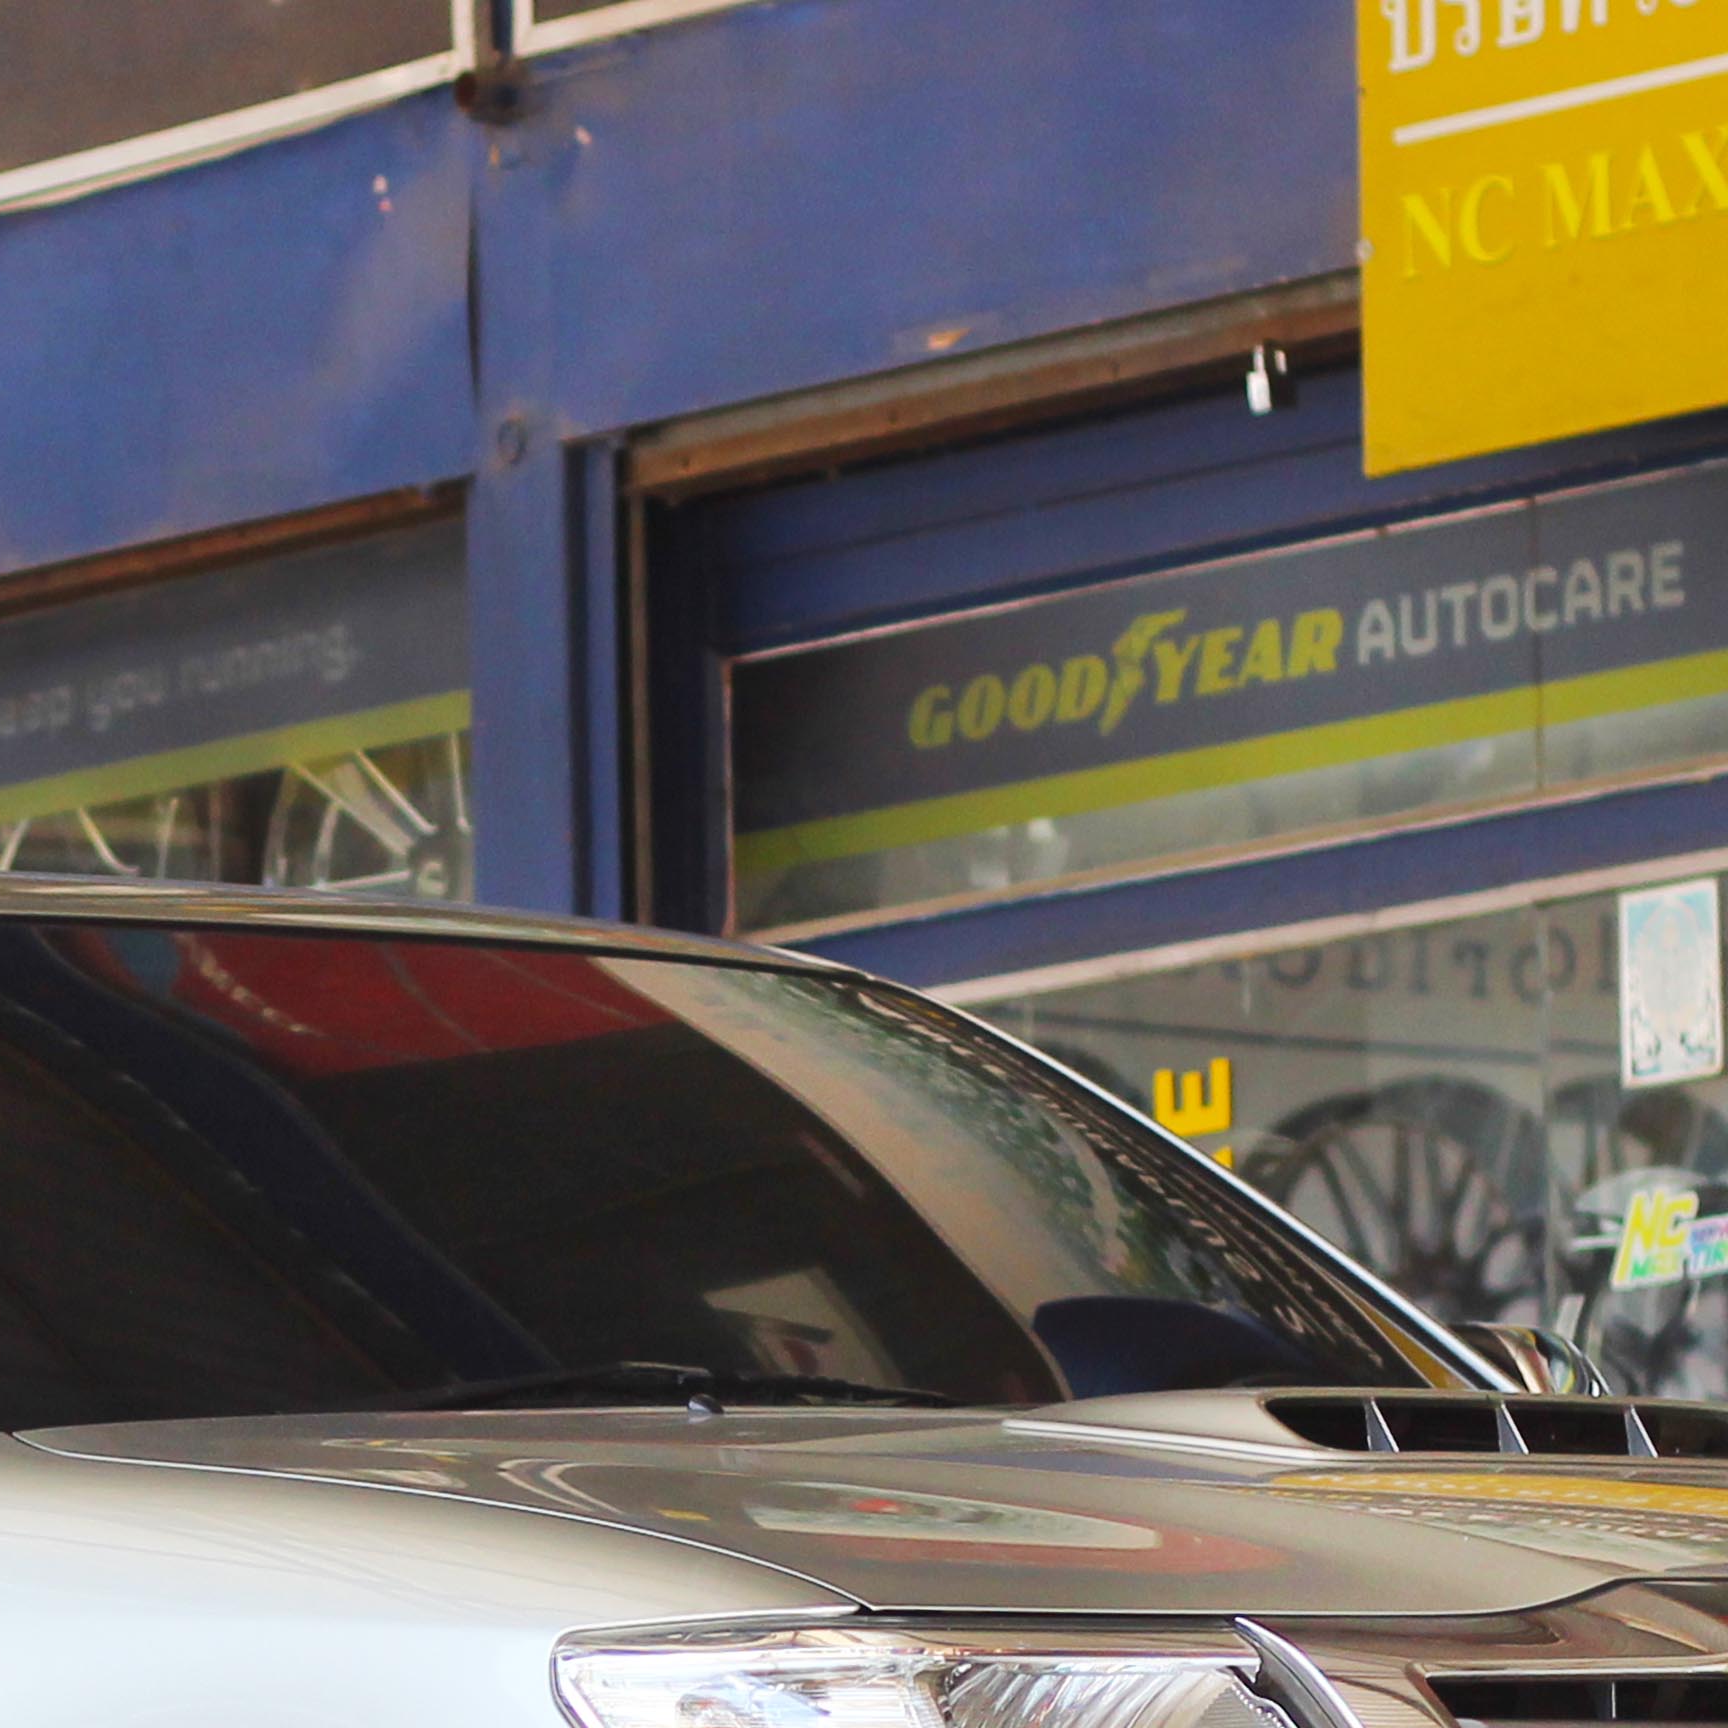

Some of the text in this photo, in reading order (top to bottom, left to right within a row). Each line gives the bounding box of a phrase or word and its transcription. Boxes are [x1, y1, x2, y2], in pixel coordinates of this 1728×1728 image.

[1400, 175, 1516, 279] NC
[906, 541, 1685, 750] GOODYEAR AUTOCARE
[1616, 1191, 1694, 1284] NC
